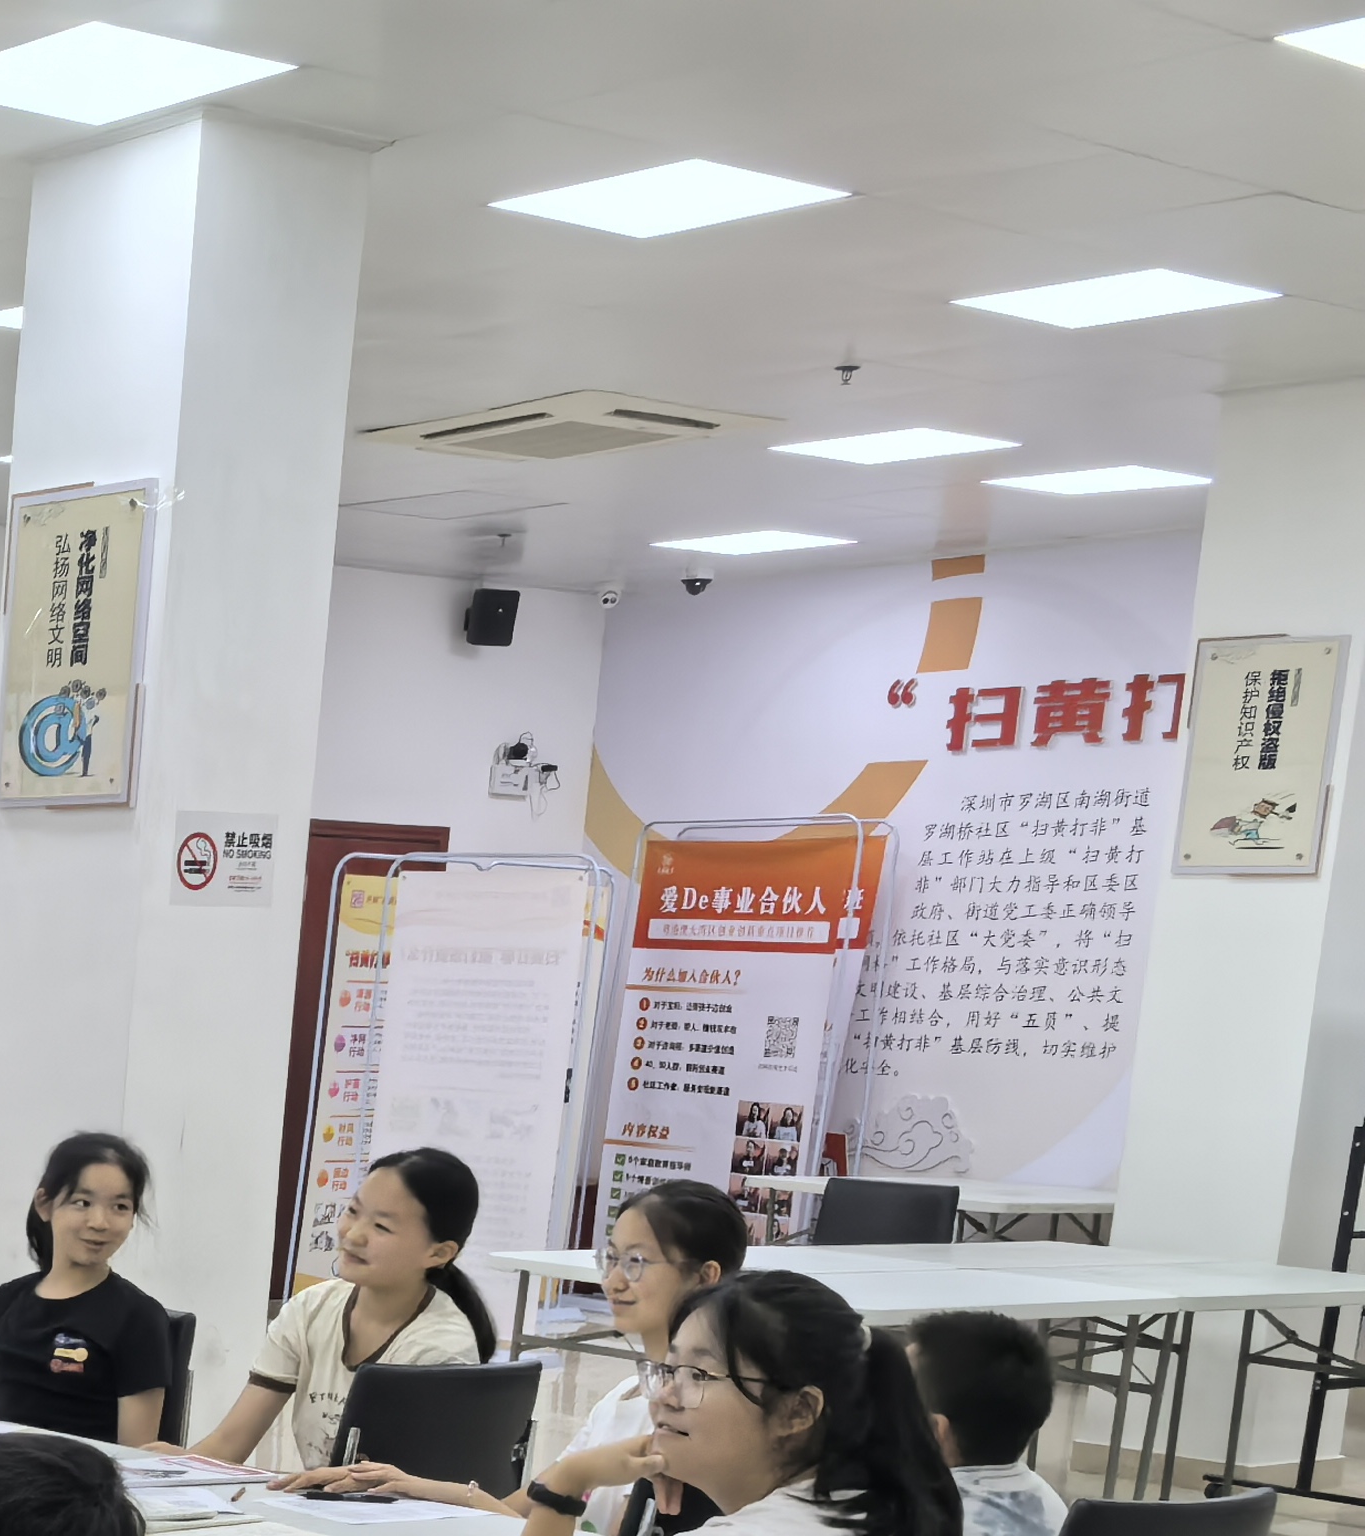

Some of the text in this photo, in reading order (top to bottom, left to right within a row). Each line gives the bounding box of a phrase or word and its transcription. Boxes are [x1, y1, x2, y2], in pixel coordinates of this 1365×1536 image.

[46, 533, 71, 669] 弘扬网络文明
[69, 529, 98, 667] 净化网络空间
[1232, 670, 1262, 771] 保护知识产权
[1257, 668, 1290, 771] 拒绝侵权盗版
[224, 831, 273, 849] 禁止吸烟
[961, 787, 1151, 813] 深圳市罗湖区南湖街道
[659, 885, 827, 915] 爱De事业合伙人
